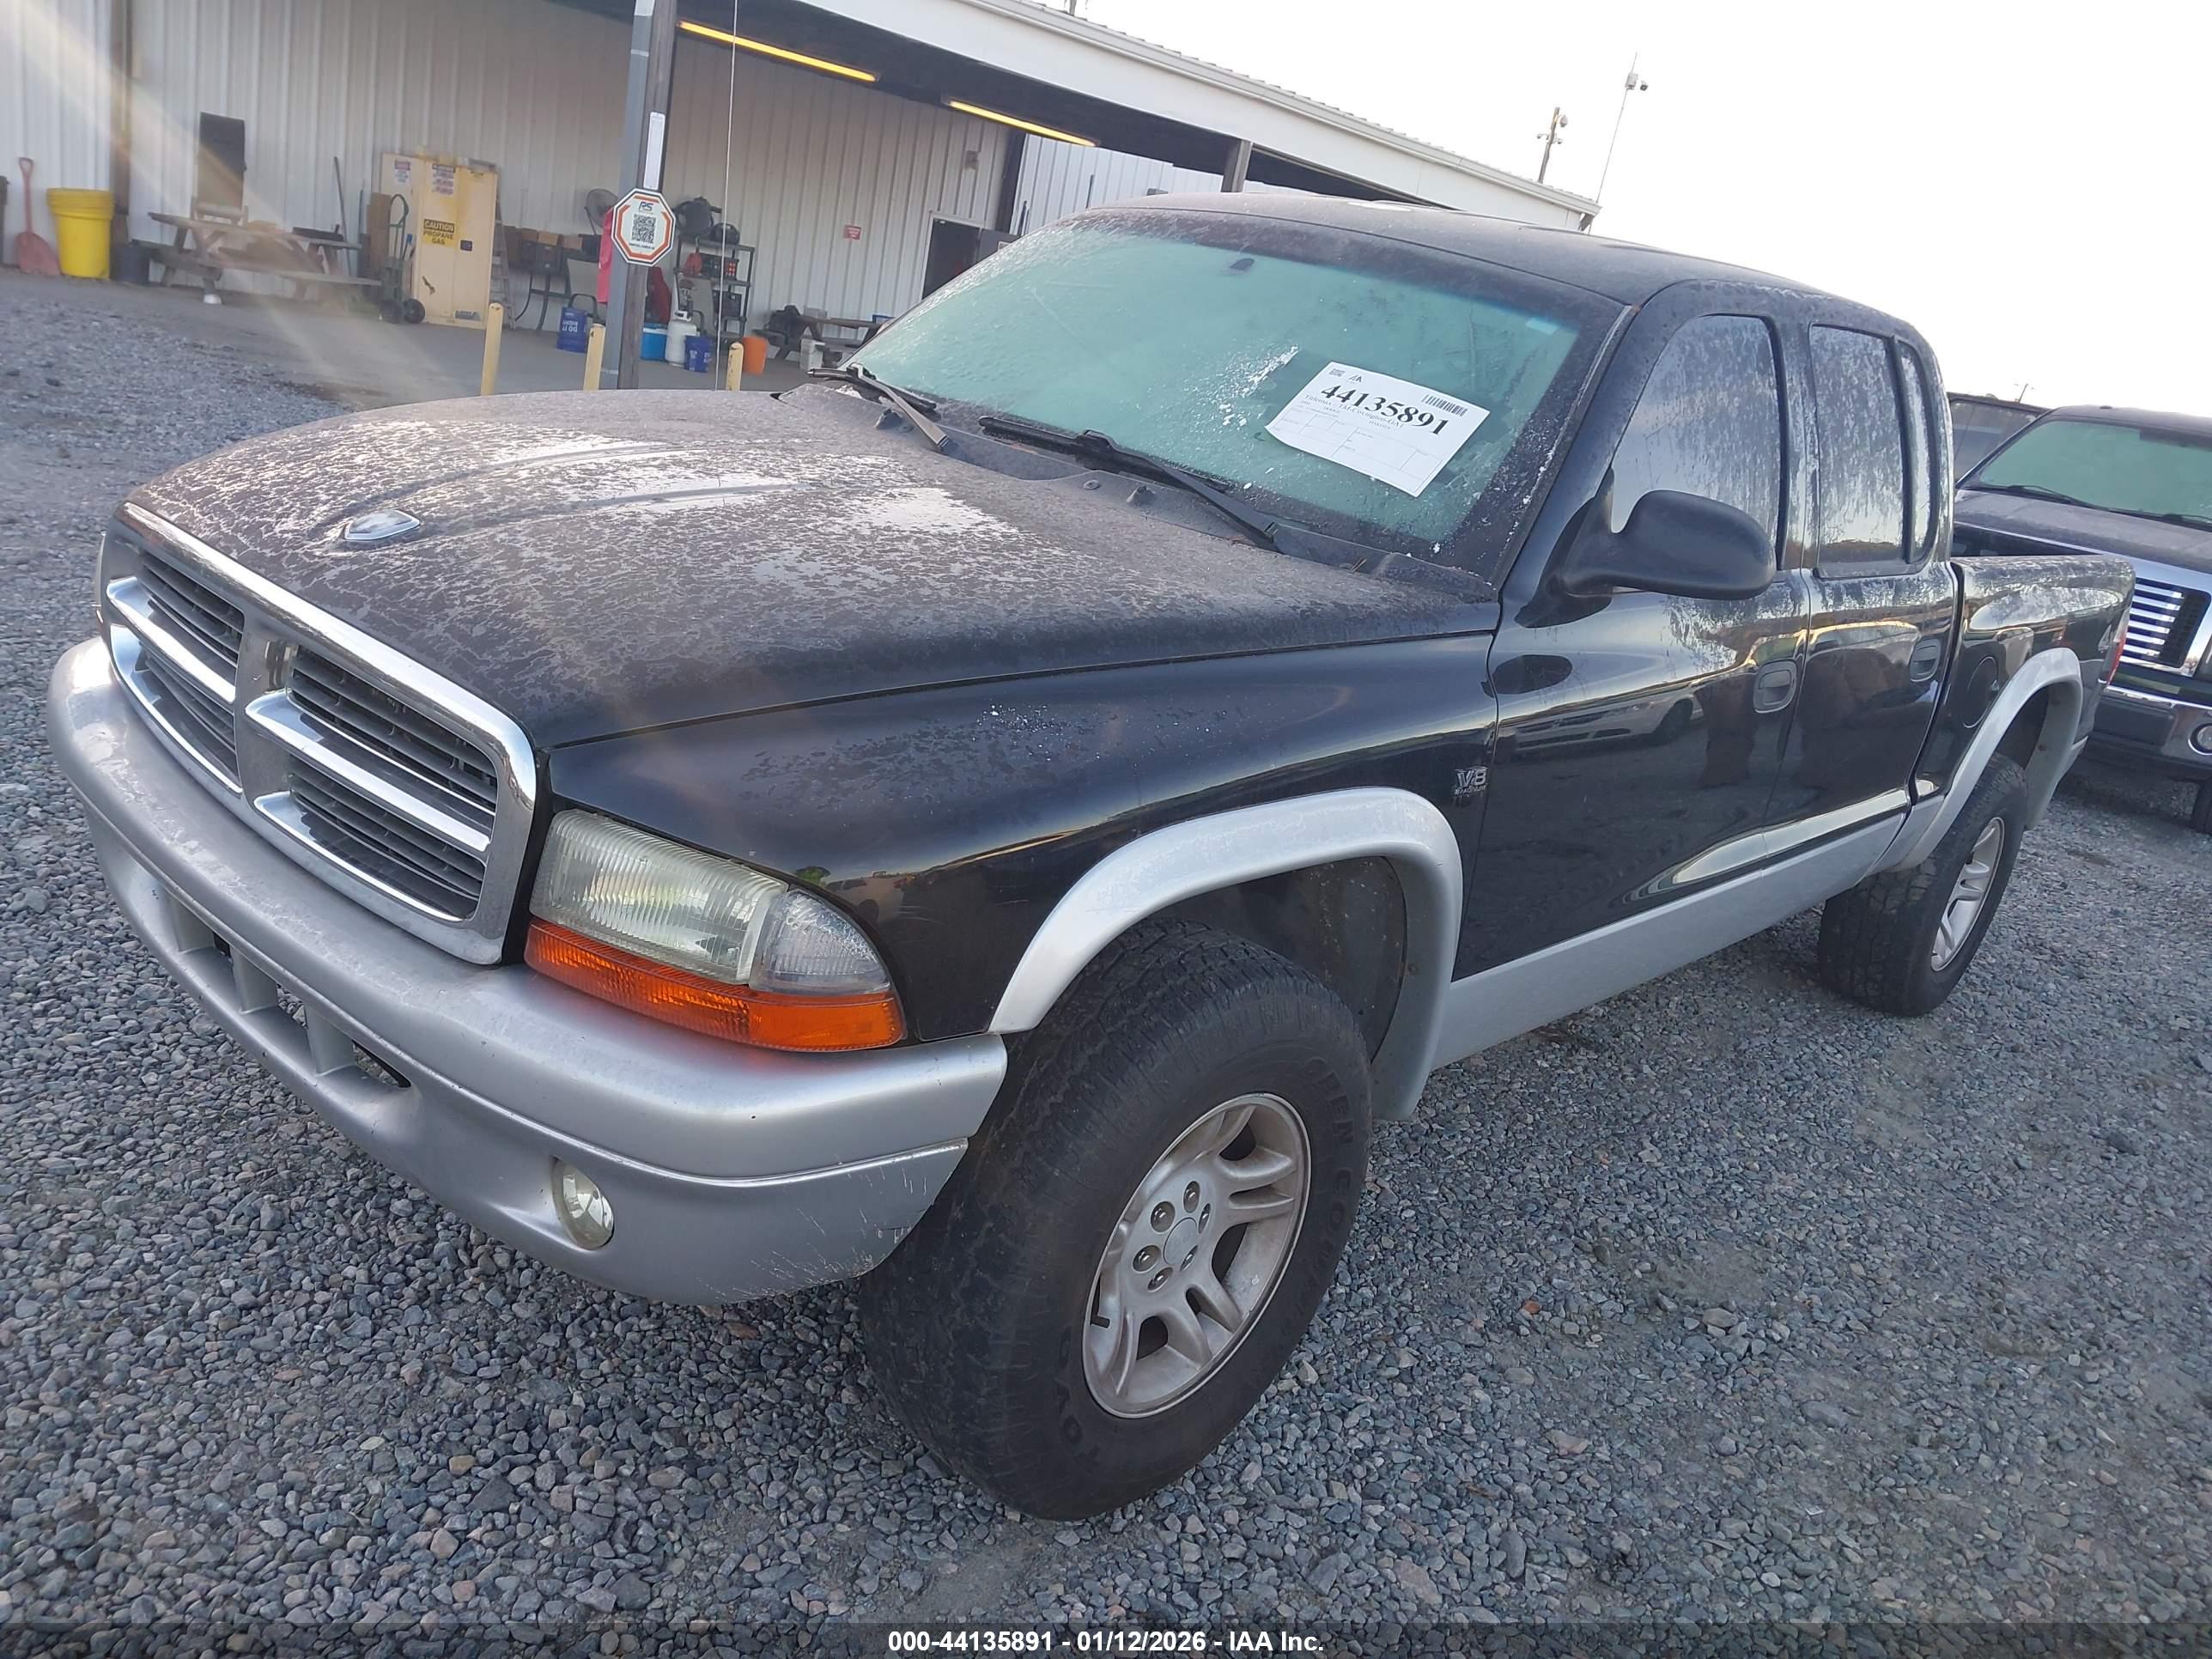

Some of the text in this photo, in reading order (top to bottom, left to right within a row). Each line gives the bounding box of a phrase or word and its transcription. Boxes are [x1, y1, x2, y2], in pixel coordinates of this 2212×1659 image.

[425, 220, 454, 232] CAUTION
[423, 231, 454, 240] PROPANE
[1322, 385, 1449, 435] 44135891
[1457, 769, 1487, 787] V8
[1304, 1056, 1354, 1146] OPEN
